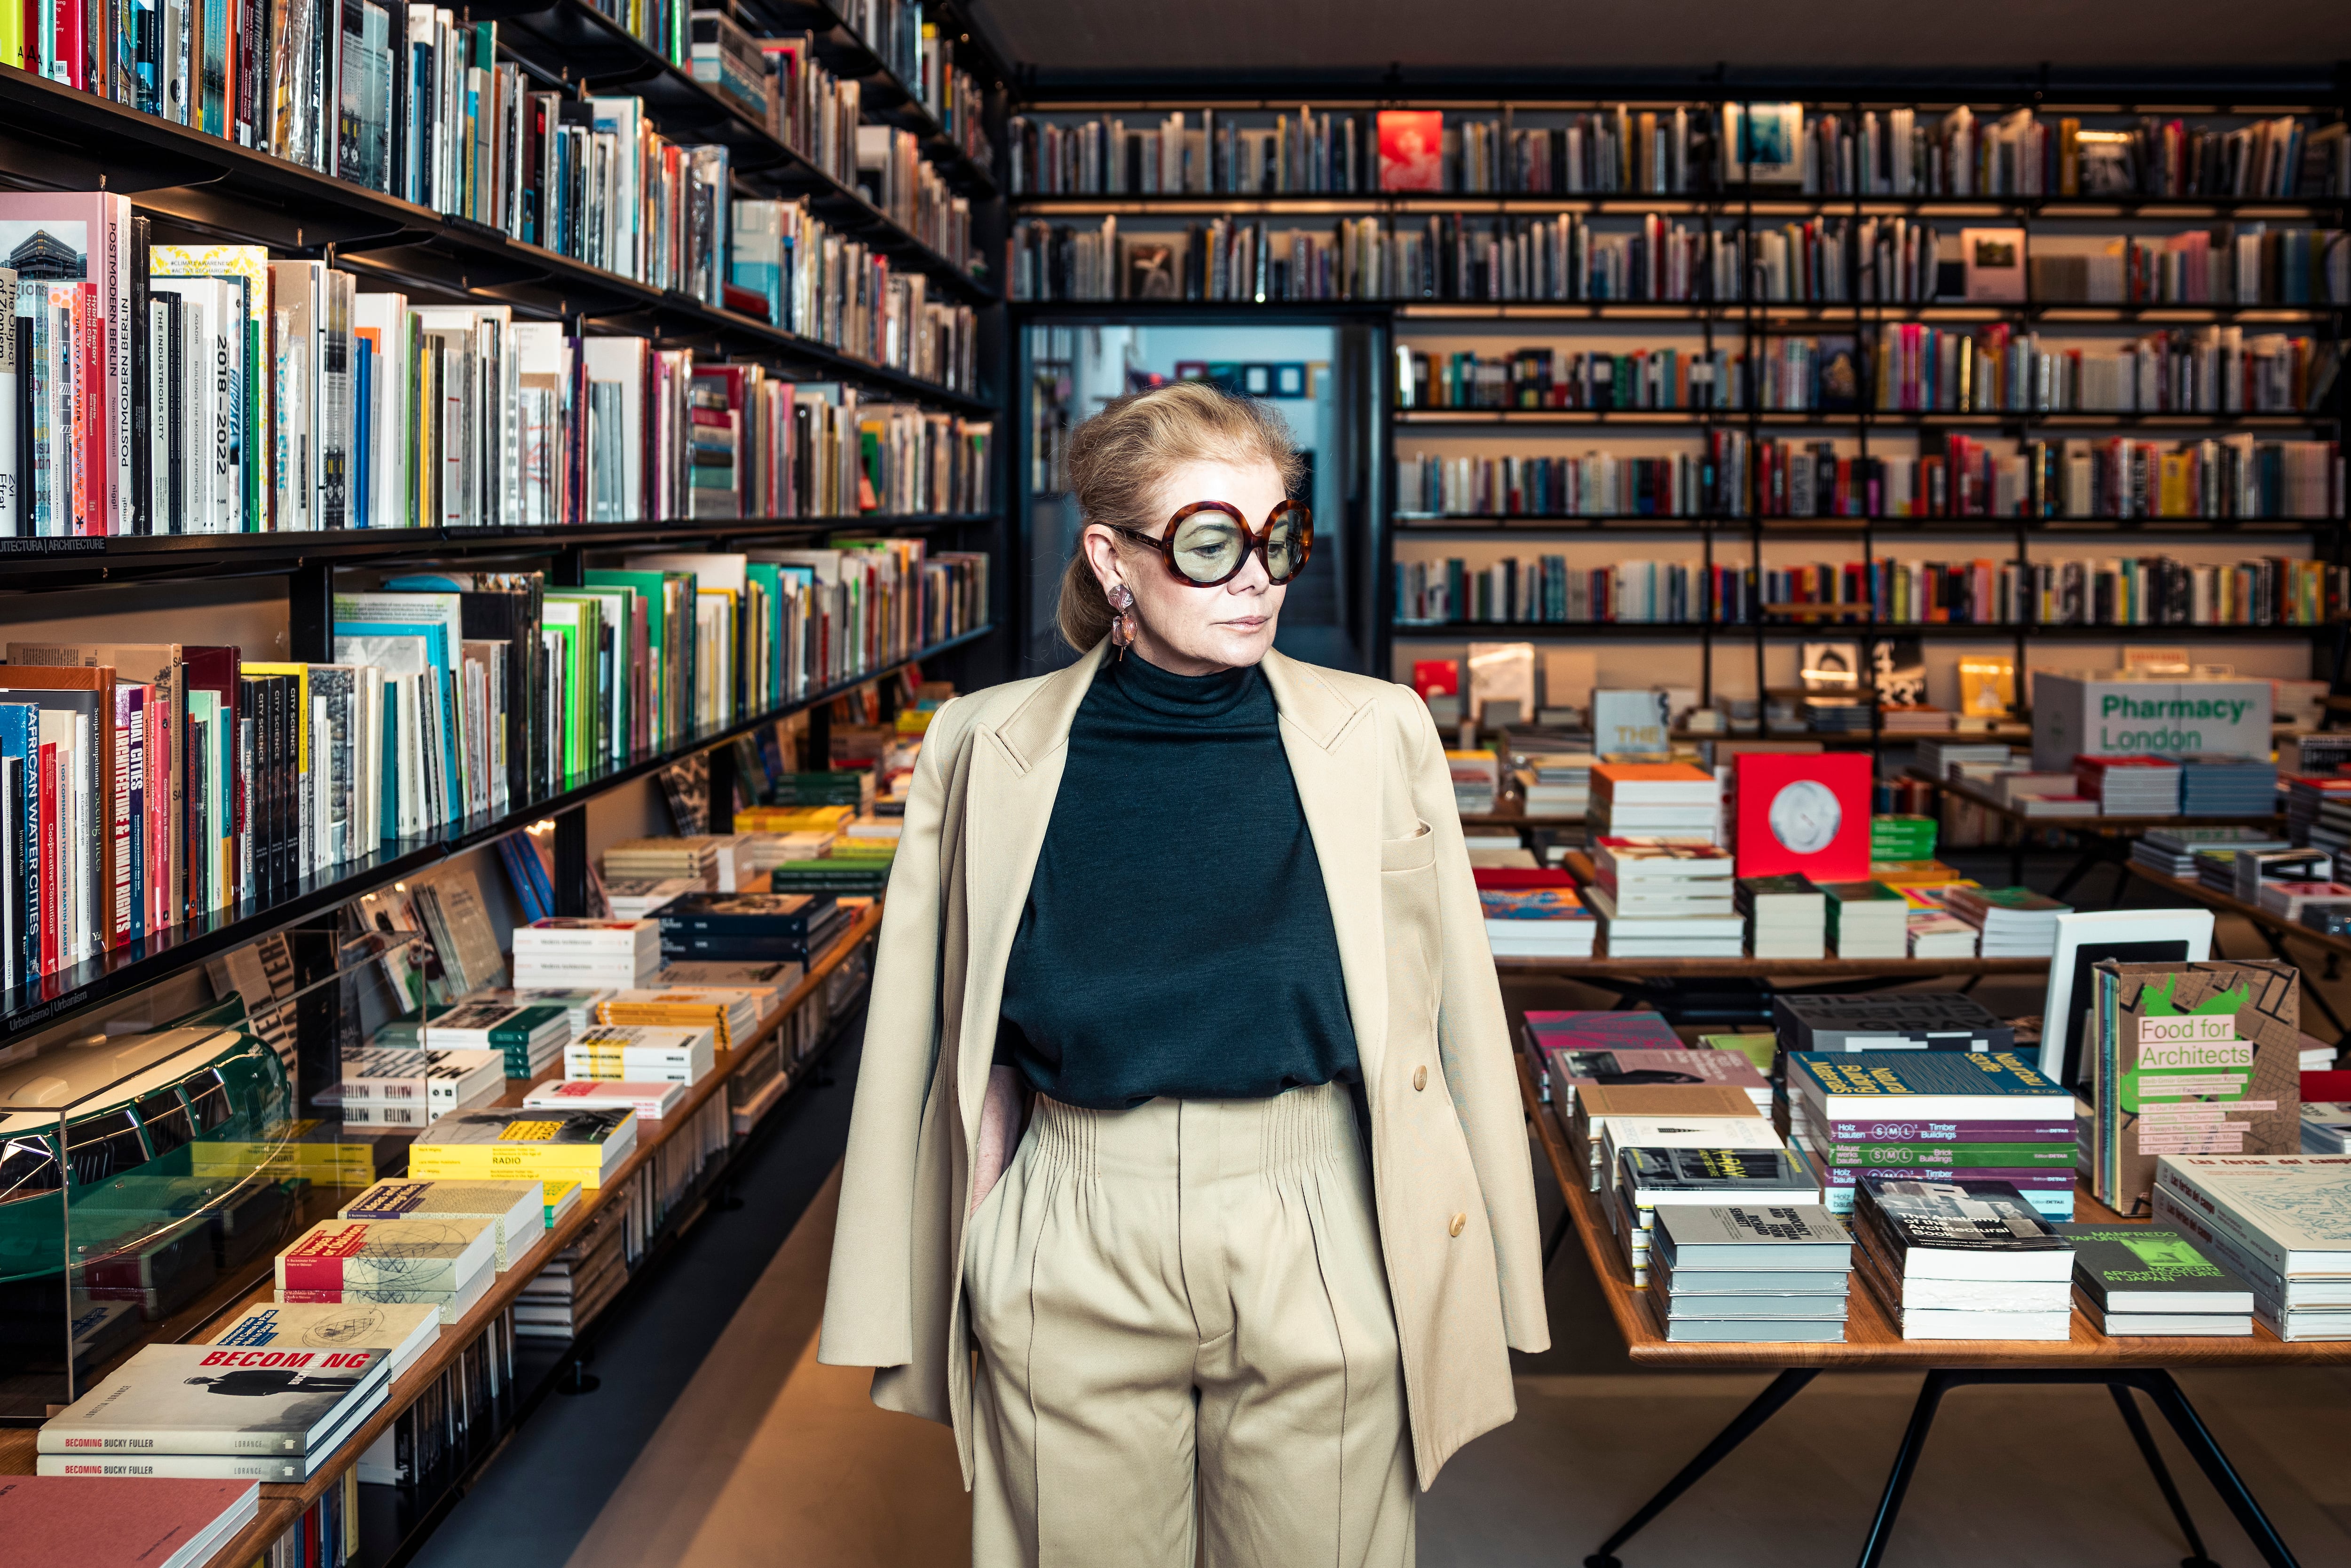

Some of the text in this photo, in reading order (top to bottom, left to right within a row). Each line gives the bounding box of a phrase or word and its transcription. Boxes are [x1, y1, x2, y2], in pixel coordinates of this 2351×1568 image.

[7, 314, 16, 366] Object
[76, 364, 80, 375] AS
[48, 538, 105, 551] ARCHITECTURE
[173, 657, 182, 668] SA
[2101, 694, 2247, 724] Pharmacy
[1615, 726, 1659, 744] THE
[2101, 726, 2202, 751] London
[130, 710, 143, 791] DUAL CITIES
[173, 790, 182, 801] SA
[27, 712, 39, 936] AFRICAN WATER CITIES
[116, 729, 131, 934] ARCHITECTURE & HUMAN RIGHTS
[9, 991, 87, 1031] Urbanismo Urbanism
[2142, 1018, 2230, 1040] Food for
[2141, 1046, 2250, 1065] Architects
[1920, 1131, 1957, 1140] Buildings
[1929, 1123, 1957, 1131] Timber
[1697, 1149, 1720, 1178] ARCHITECTURE
[1711, 1149, 1748, 1178] X-RAY
[1919, 1155, 1953, 1164] Buildings
[2170, 1173, 2216, 1215] Las ferias del campo
[1728, 1207, 1753, 1228] SENNETT
[1746, 1215, 1771, 1236] RICHARD
[1767, 1207, 1802, 1240] AND URBAN
[1781, 1207, 1814, 1237] DEMOCRACY
[1909, 1223, 2010, 1233] Architectural
[1932, 1214, 2001, 1223] Anatomy
[329, 1225, 365, 1249] Oblivion
[1765, 1224, 1787, 1238] FORM
[300, 1237, 334, 1256] Utopia
[287, 1368, 312, 1385] BUCKY
[83, 1385, 132, 1418] LORETTA LORANCE
[65, 1439, 153, 1448] BECOMING BUCKY FULLER
[65, 1466, 153, 1475] BECOMING BUCKY FULLER
